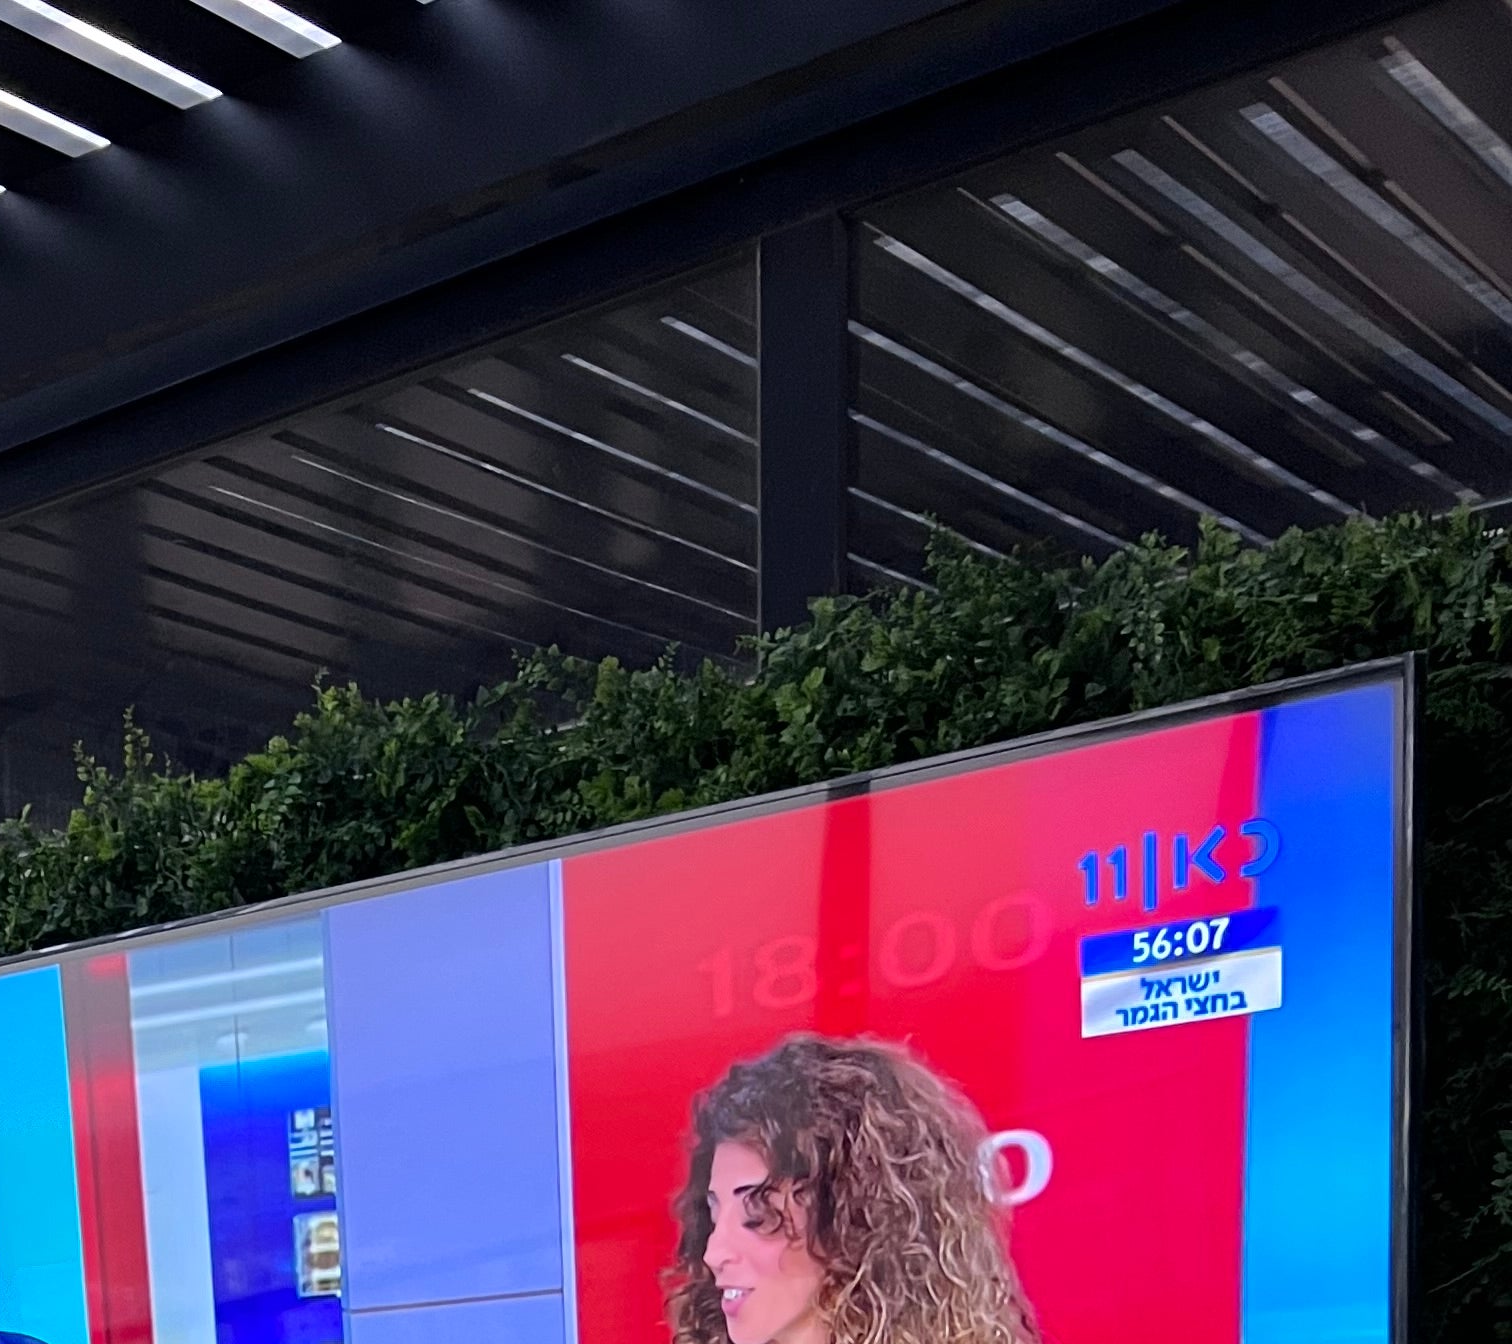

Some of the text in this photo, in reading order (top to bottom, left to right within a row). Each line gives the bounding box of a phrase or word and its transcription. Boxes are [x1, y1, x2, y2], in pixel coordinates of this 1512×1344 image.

[1131, 915, 1232, 964] 56:07
[1140, 968, 1222, 1001] ישראל
[1115, 990, 1249, 1027] בחצי הגמר
